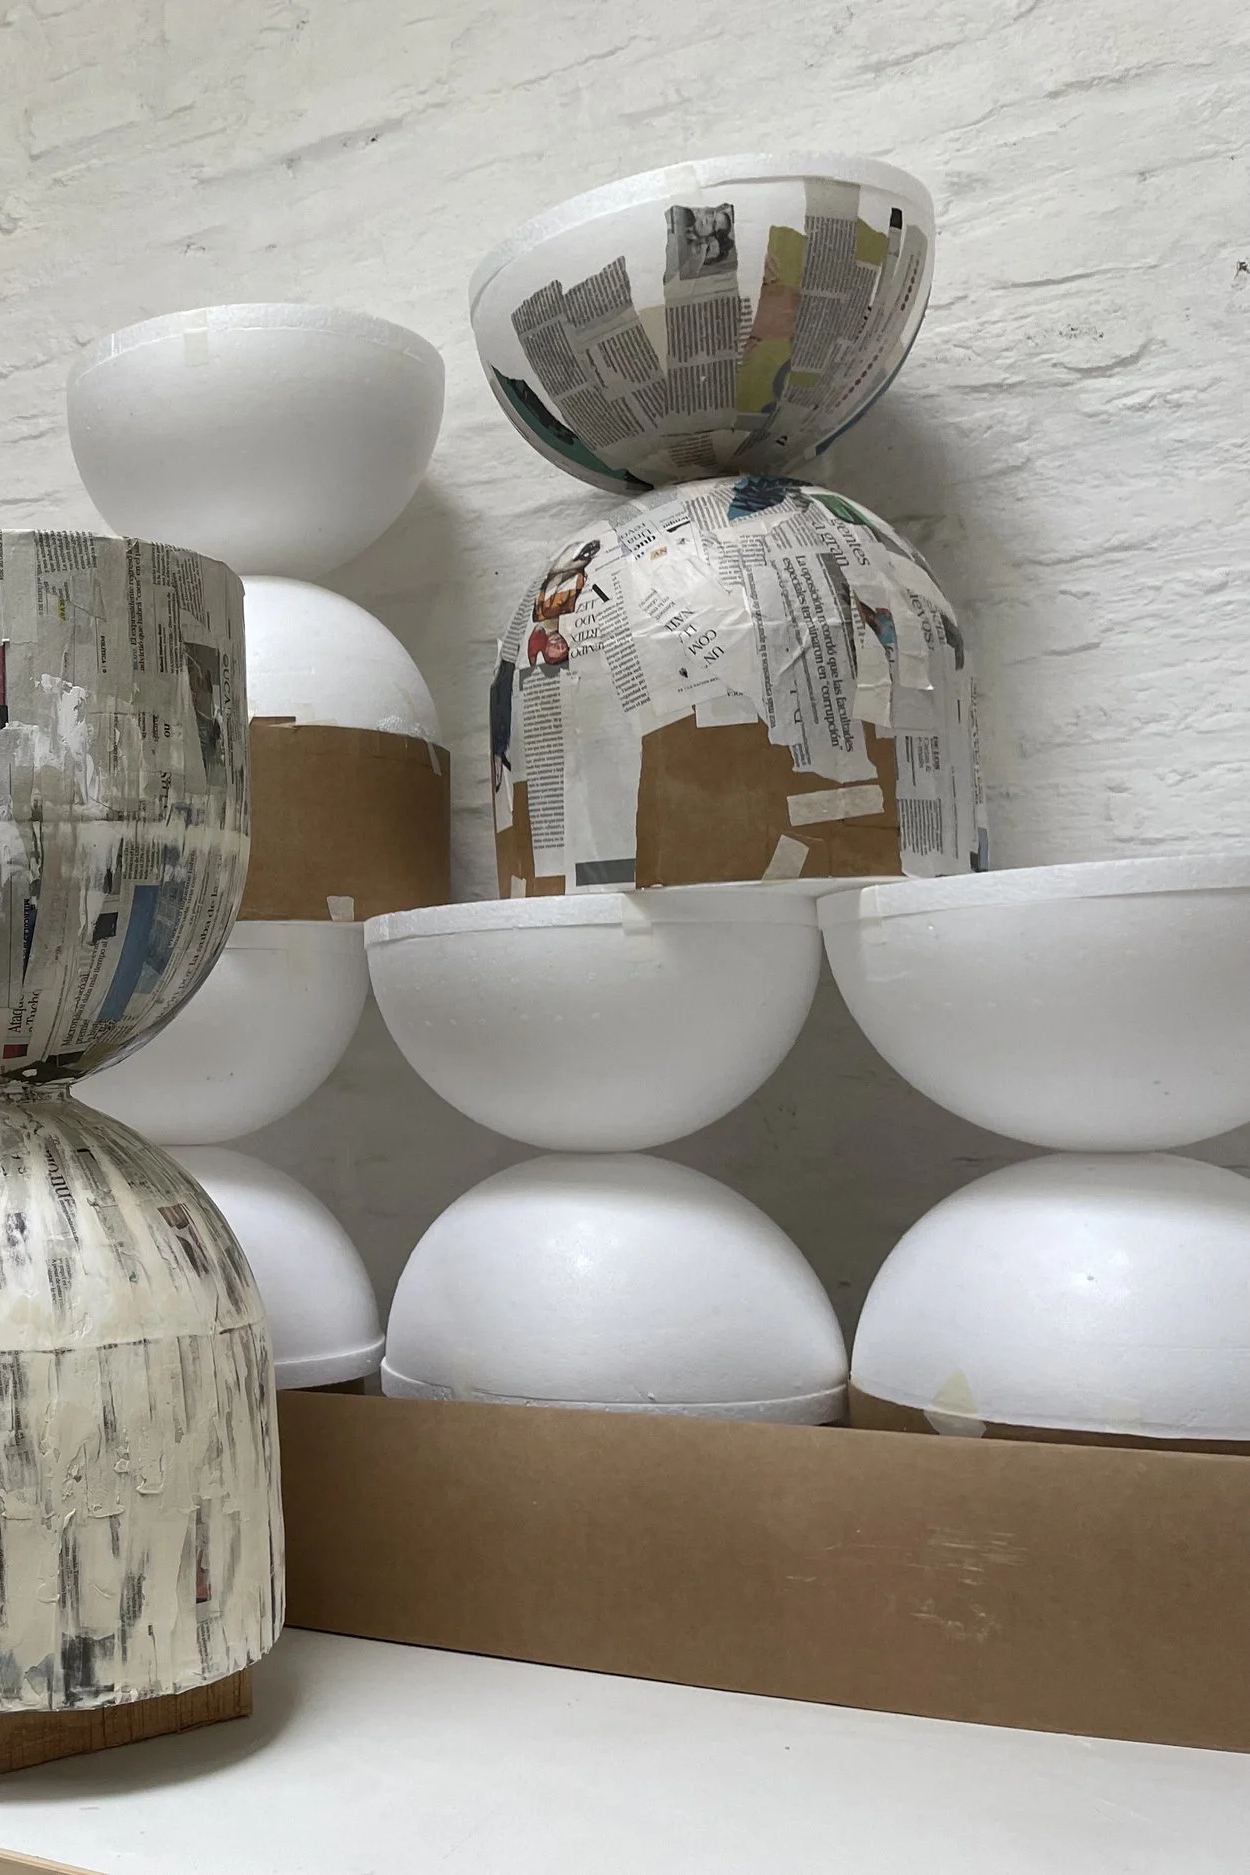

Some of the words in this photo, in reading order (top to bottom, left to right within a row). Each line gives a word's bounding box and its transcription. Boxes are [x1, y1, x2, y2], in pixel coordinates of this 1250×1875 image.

[795, 555, 808, 567] La
[798, 568, 824, 614] oposición
[128, 585, 136, 636] expresidente
[782, 557, 809, 605] especiales
[817, 666, 828, 680] en
[760, 659, 772, 697] expuestos
[825, 657, 841, 679] que
[766, 697, 774, 714] más
[833, 680, 846, 695] las
[835, 696, 855, 752] facultades
